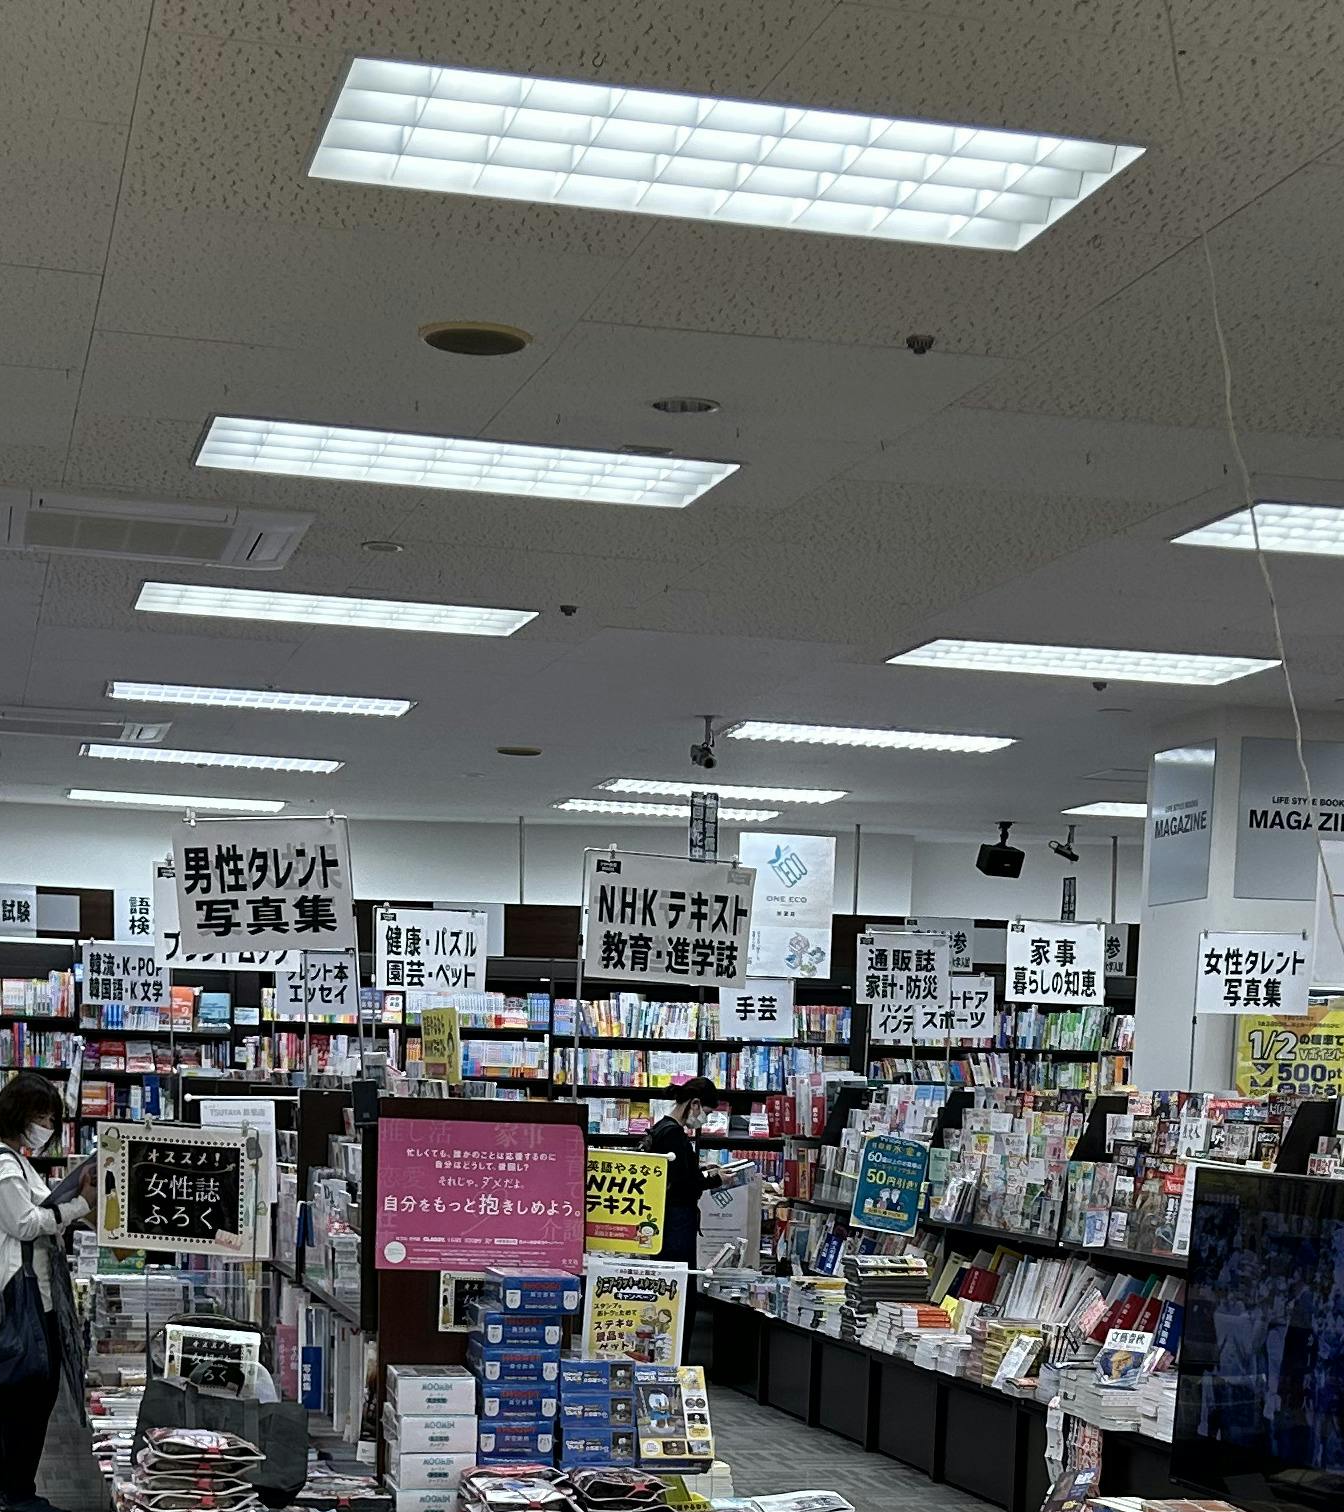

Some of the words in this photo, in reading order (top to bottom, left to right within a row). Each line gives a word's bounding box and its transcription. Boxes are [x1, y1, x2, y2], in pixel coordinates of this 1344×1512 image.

[1272, 796, 1289, 804] LIFE
[1292, 797, 1317, 806] STYE
[1154, 810, 1207, 839] MAGAZINE
[184, 846, 340, 895] 男性タレント
[599, 885, 658, 927] NHK
[668, 891, 748, 935] テキスト
[789, 896, 807, 904] ECO
[196, 895, 337, 936] 写真集
[385, 925, 478, 957] 健康・パズル
[602, 930, 739, 978] 教育・進学誌
[1030, 939, 1077, 967] 家事
[868, 948, 935, 972] 通販誌
[1204, 949, 1306, 977] 女性タレント
[386, 960, 476, 988] 園芸・ペット
[865, 974, 938, 1000] 家計・防災
[1013, 967, 1096, 997] 暮らしの知恵
[289, 984, 348, 1005] エッセイ
[1223, 979, 1282, 1008] 写真集
[736, 996, 777, 1022] 手芸
[923, 1011, 985, 1030] スポーツ
[1249, 1029, 1296, 1060] 1/2
[148, 1148, 220, 1166] オススメ!
[587, 1160, 663, 1178] 英語やるなら
[144, 1173, 221, 1203] 女性誌
[587, 1175, 647, 1195] NHK
[144, 1205, 213, 1230] ふろく
[384, 1194, 581, 1217] 自分をもっと抱きしめよう。
[587, 1196, 652, 1216] テキスト
